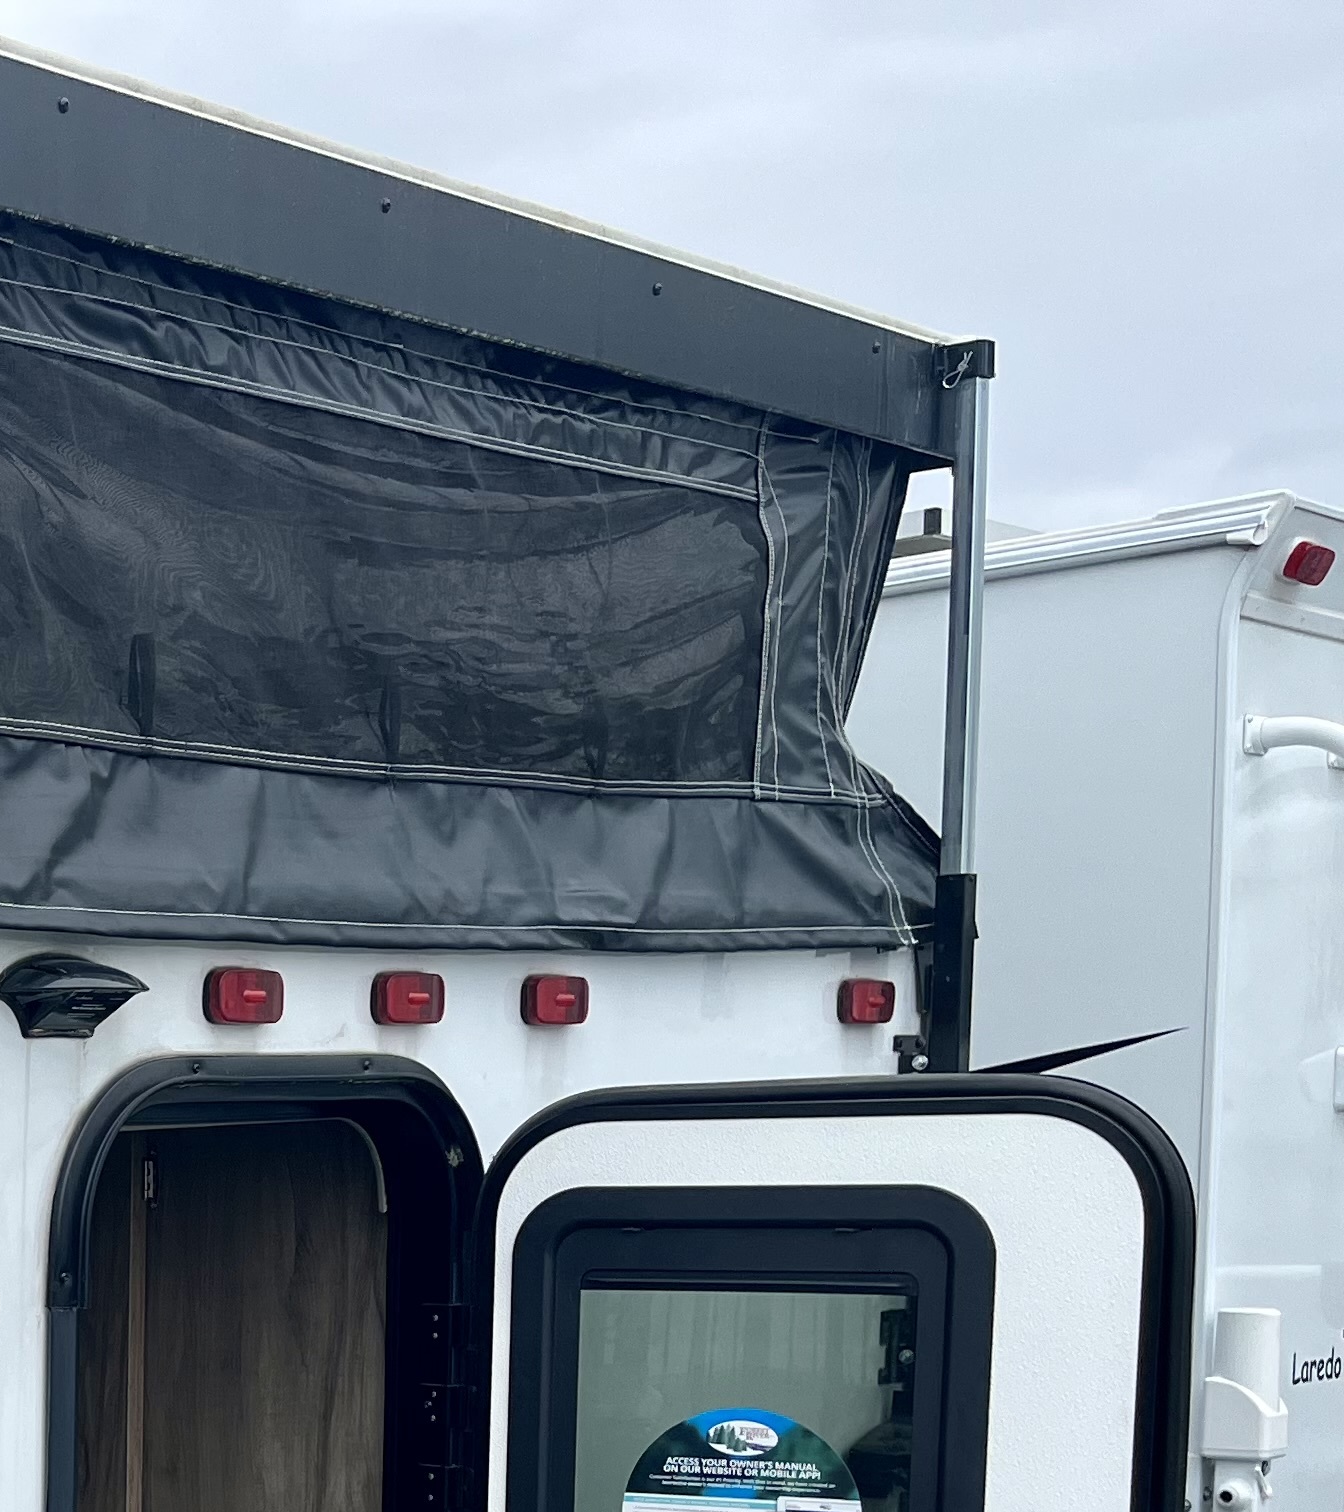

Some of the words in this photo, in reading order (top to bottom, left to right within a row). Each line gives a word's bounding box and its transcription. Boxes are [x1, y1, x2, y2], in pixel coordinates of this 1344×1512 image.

[1292, 1346, 1342, 1386] Laredo
[663, 1464, 679, 1473] ON
[679, 1465, 701, 1474] OUR
[702, 1466, 743, 1476] WEBSITE
[744, 1468, 759, 1477] OR
[760, 1469, 797, 1479] MOBILE
[665, 1456, 699, 1466] ACCESS
[700, 1457, 727, 1467] YOUR
[728, 1459, 773, 1470] OWNER'S
[774, 1461, 818, 1472] MANUAL
